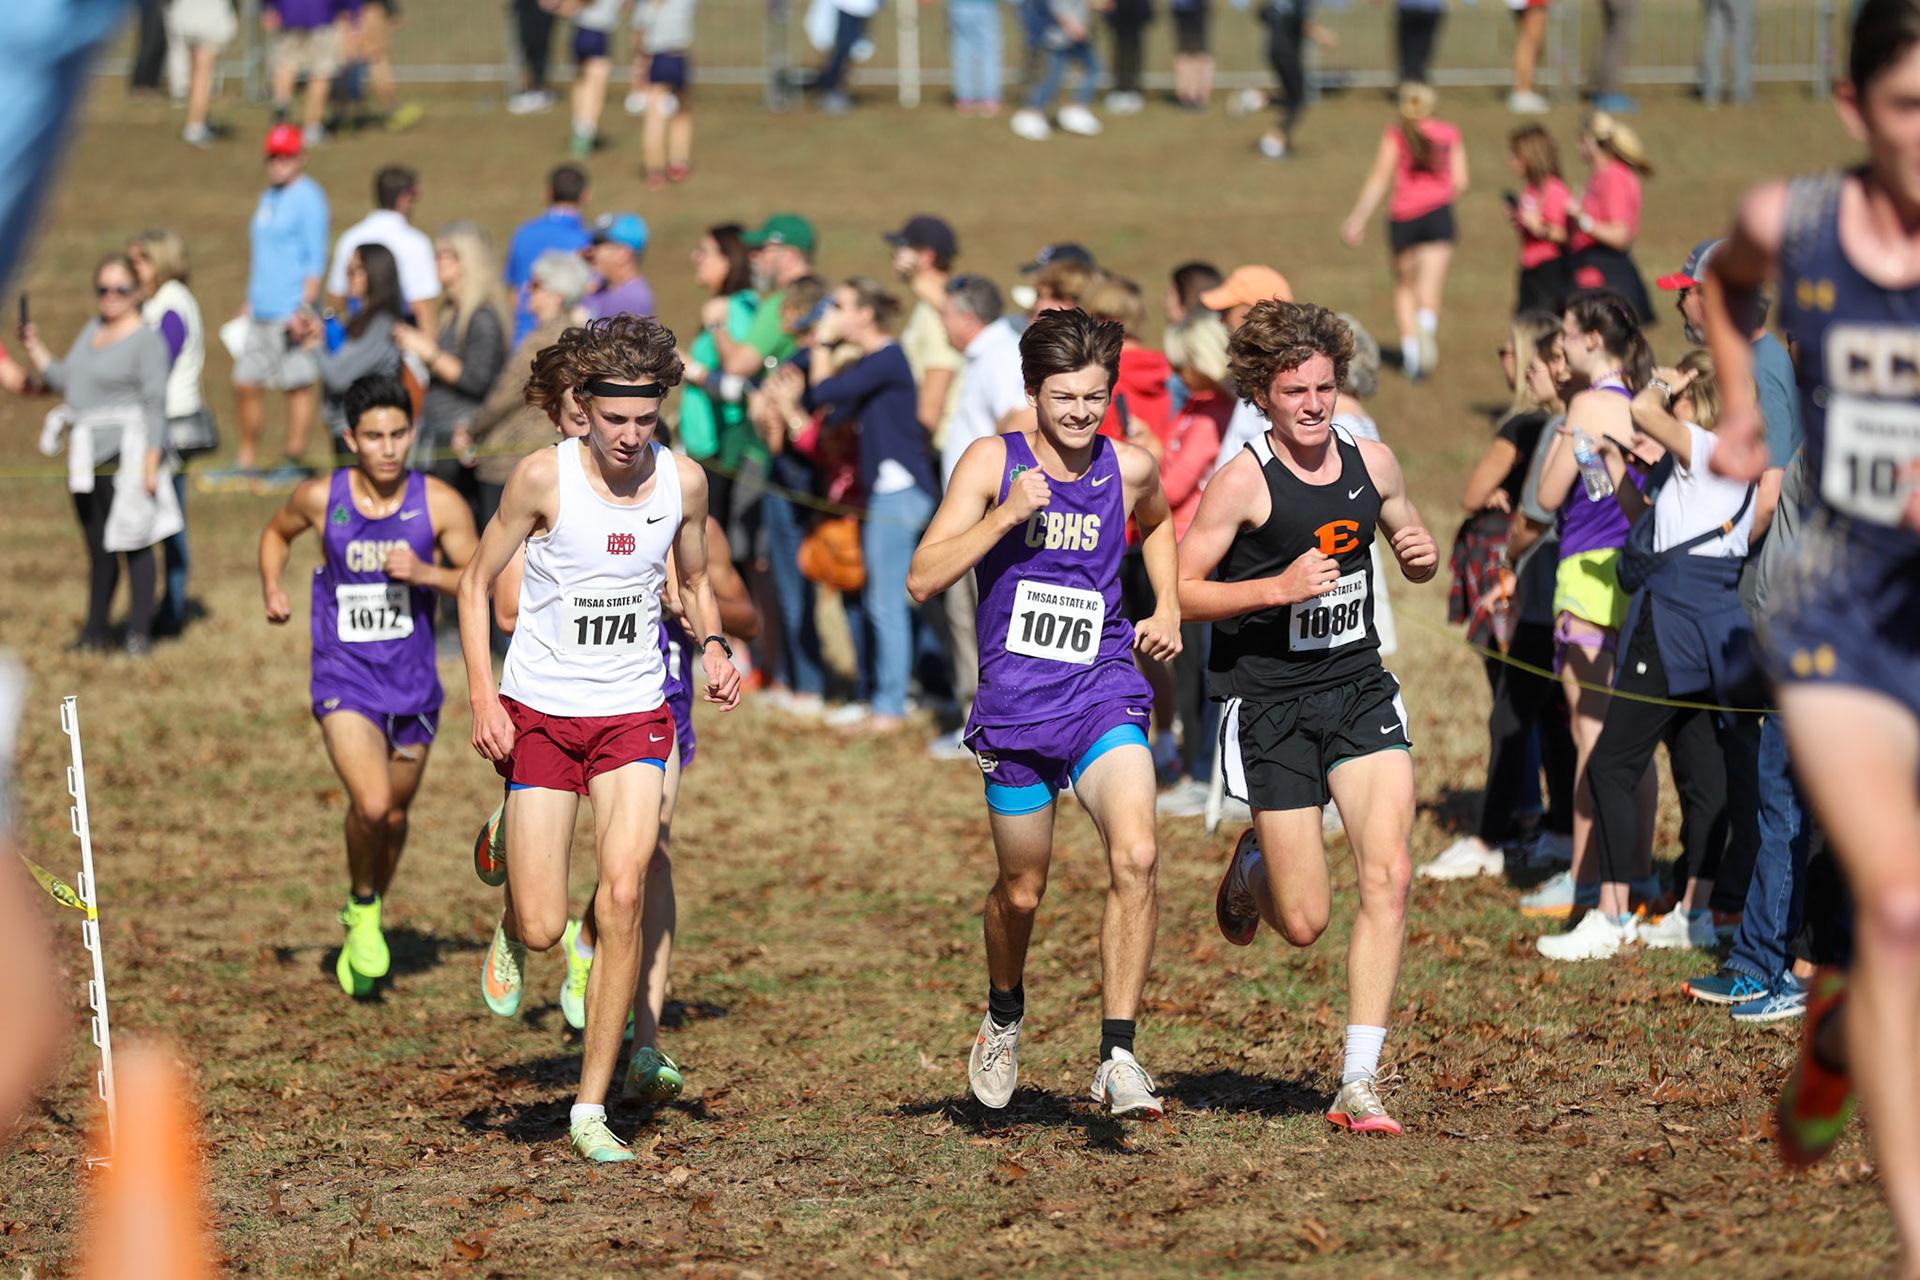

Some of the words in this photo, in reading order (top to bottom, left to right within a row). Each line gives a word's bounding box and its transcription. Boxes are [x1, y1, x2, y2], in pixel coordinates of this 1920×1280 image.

[1025, 511, 1100, 551] CBHS
[1314, 519, 1360, 555] E
[574, 597, 605, 608] TMSAA
[606, 596, 631, 608] STATE
[631, 594, 643, 605] XC
[1027, 590, 1058, 605] TMSAA
[1059, 596, 1085, 607] STATE
[1086, 600, 1098, 611] XC
[349, 606, 402, 630] 1072
[574, 613, 637, 645] 1174
[1020, 610, 1093, 653] 1076
[1297, 599, 1361, 640] 1088
